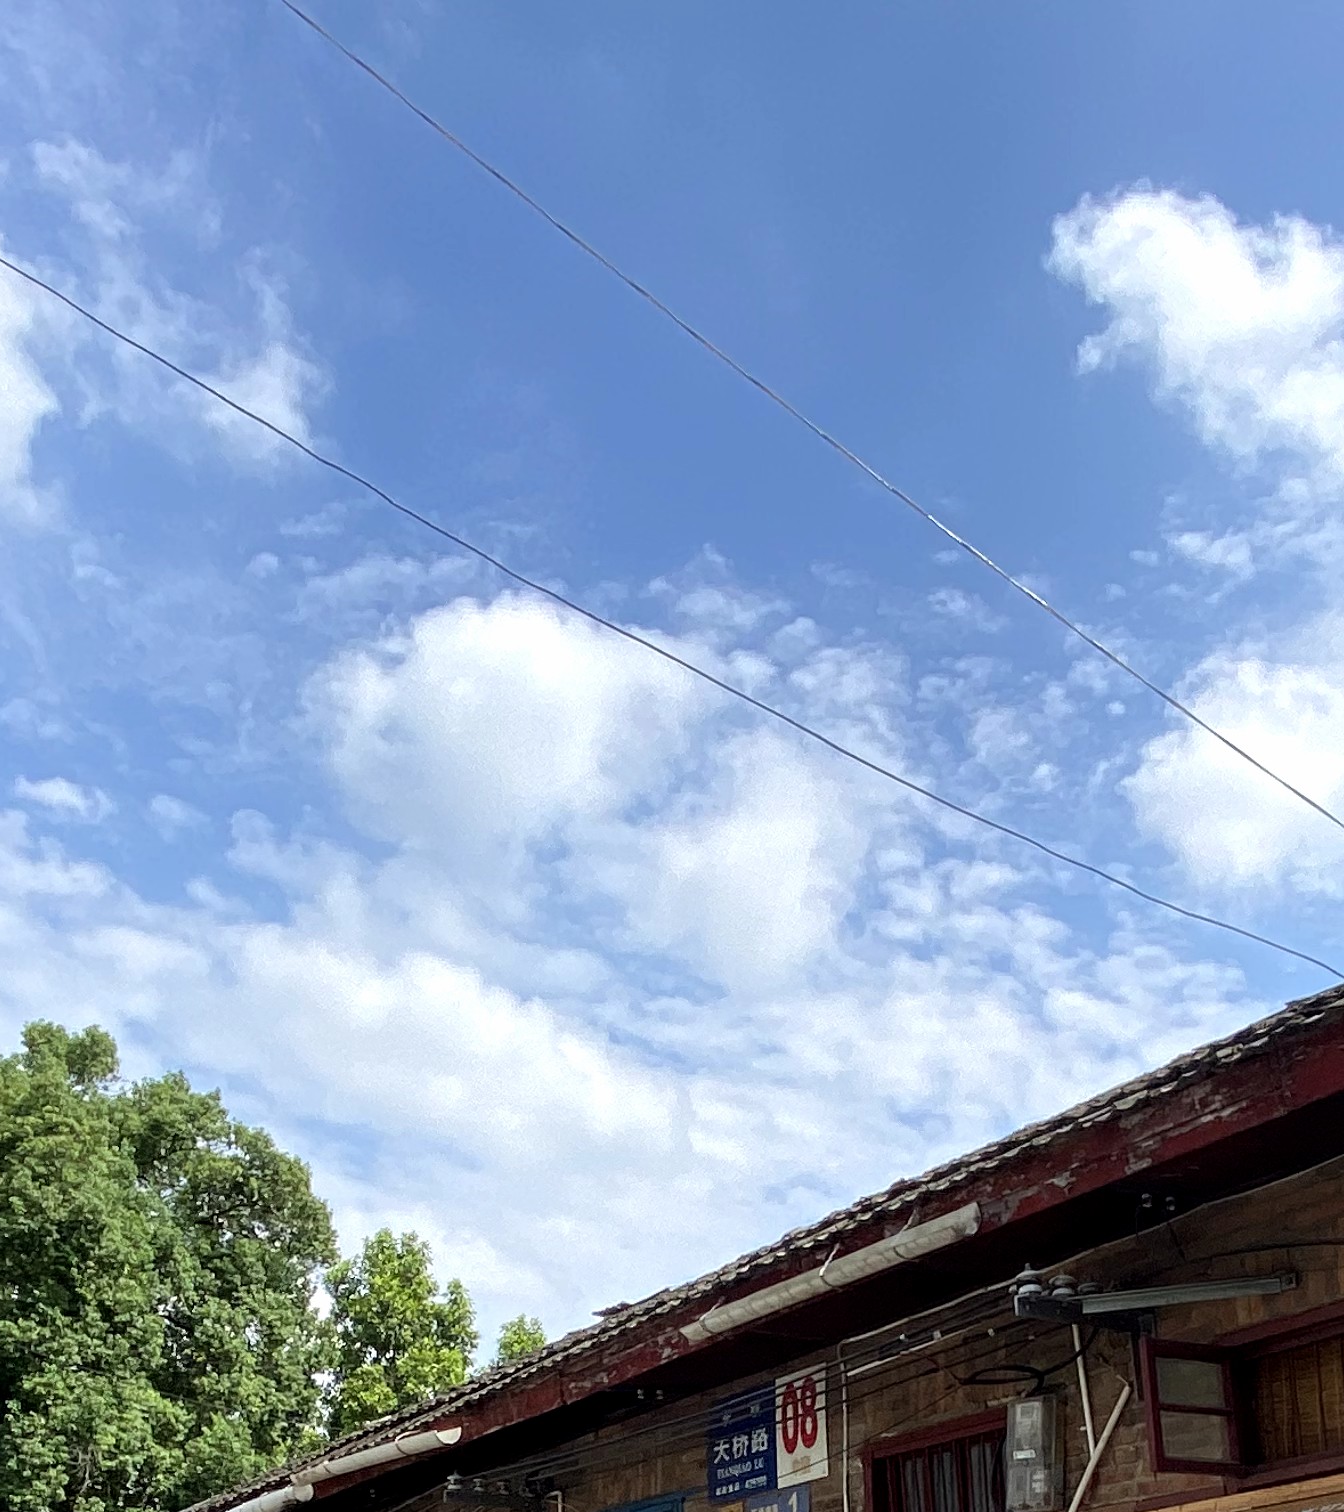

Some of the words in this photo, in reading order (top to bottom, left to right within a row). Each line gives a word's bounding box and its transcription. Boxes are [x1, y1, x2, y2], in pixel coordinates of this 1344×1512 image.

[782, 1376, 818, 1455] 08
[713, 1427, 768, 1464] 天桥路
